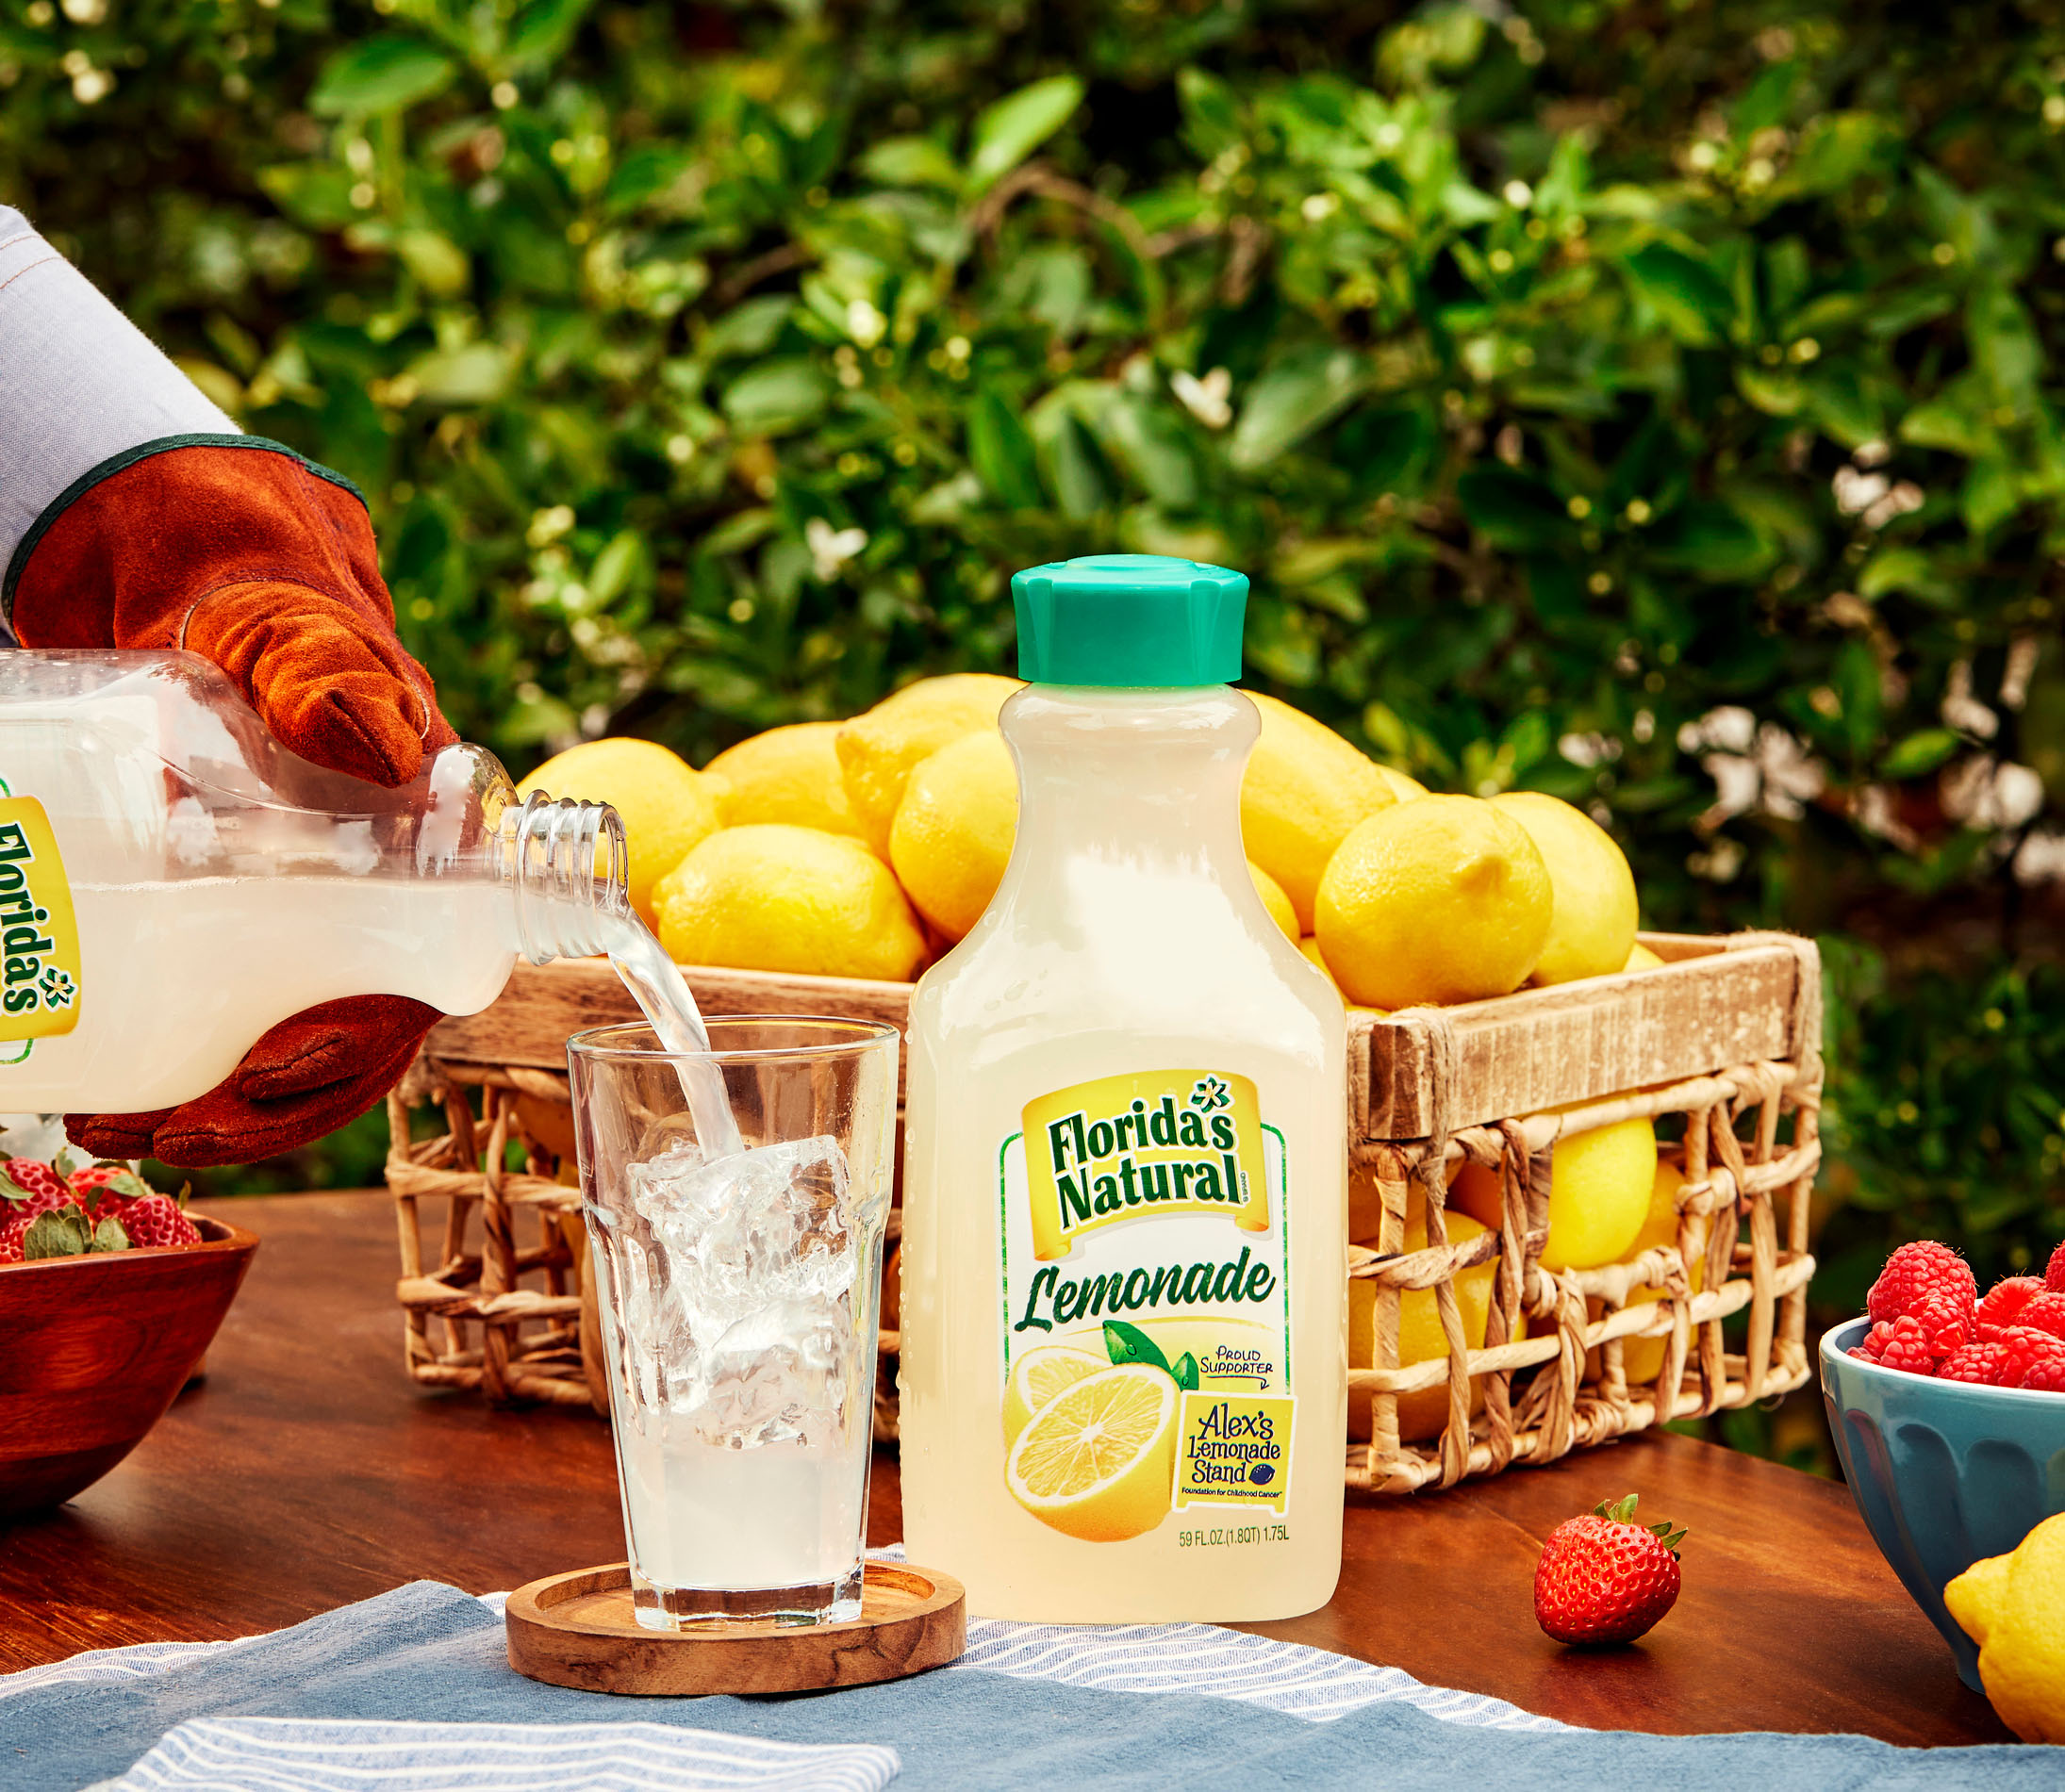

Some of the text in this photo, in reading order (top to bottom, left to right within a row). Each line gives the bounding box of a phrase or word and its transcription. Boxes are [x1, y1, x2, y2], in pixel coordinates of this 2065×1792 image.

[1056, 1154, 1241, 1229] Natural
[1014, 1245, 1276, 1333] Lemonade
[1200, 1356, 1274, 1373] SUPPORTER
[1215, 1345, 1261, 1361] PROUD
[1198, 1402, 1274, 1440] Alex's
[1187, 1435, 1280, 1463] Lemonade
[1192, 1459, 1246, 1485] Stand
[1181, 1487, 1216, 1496] Foundation
[1216, 1488, 1226, 1496] for
[1227, 1488, 1258, 1498] Childhood
[1179, 1531, 1193, 1547] 59
[1264, 1524, 1290, 1542] 1.75L
